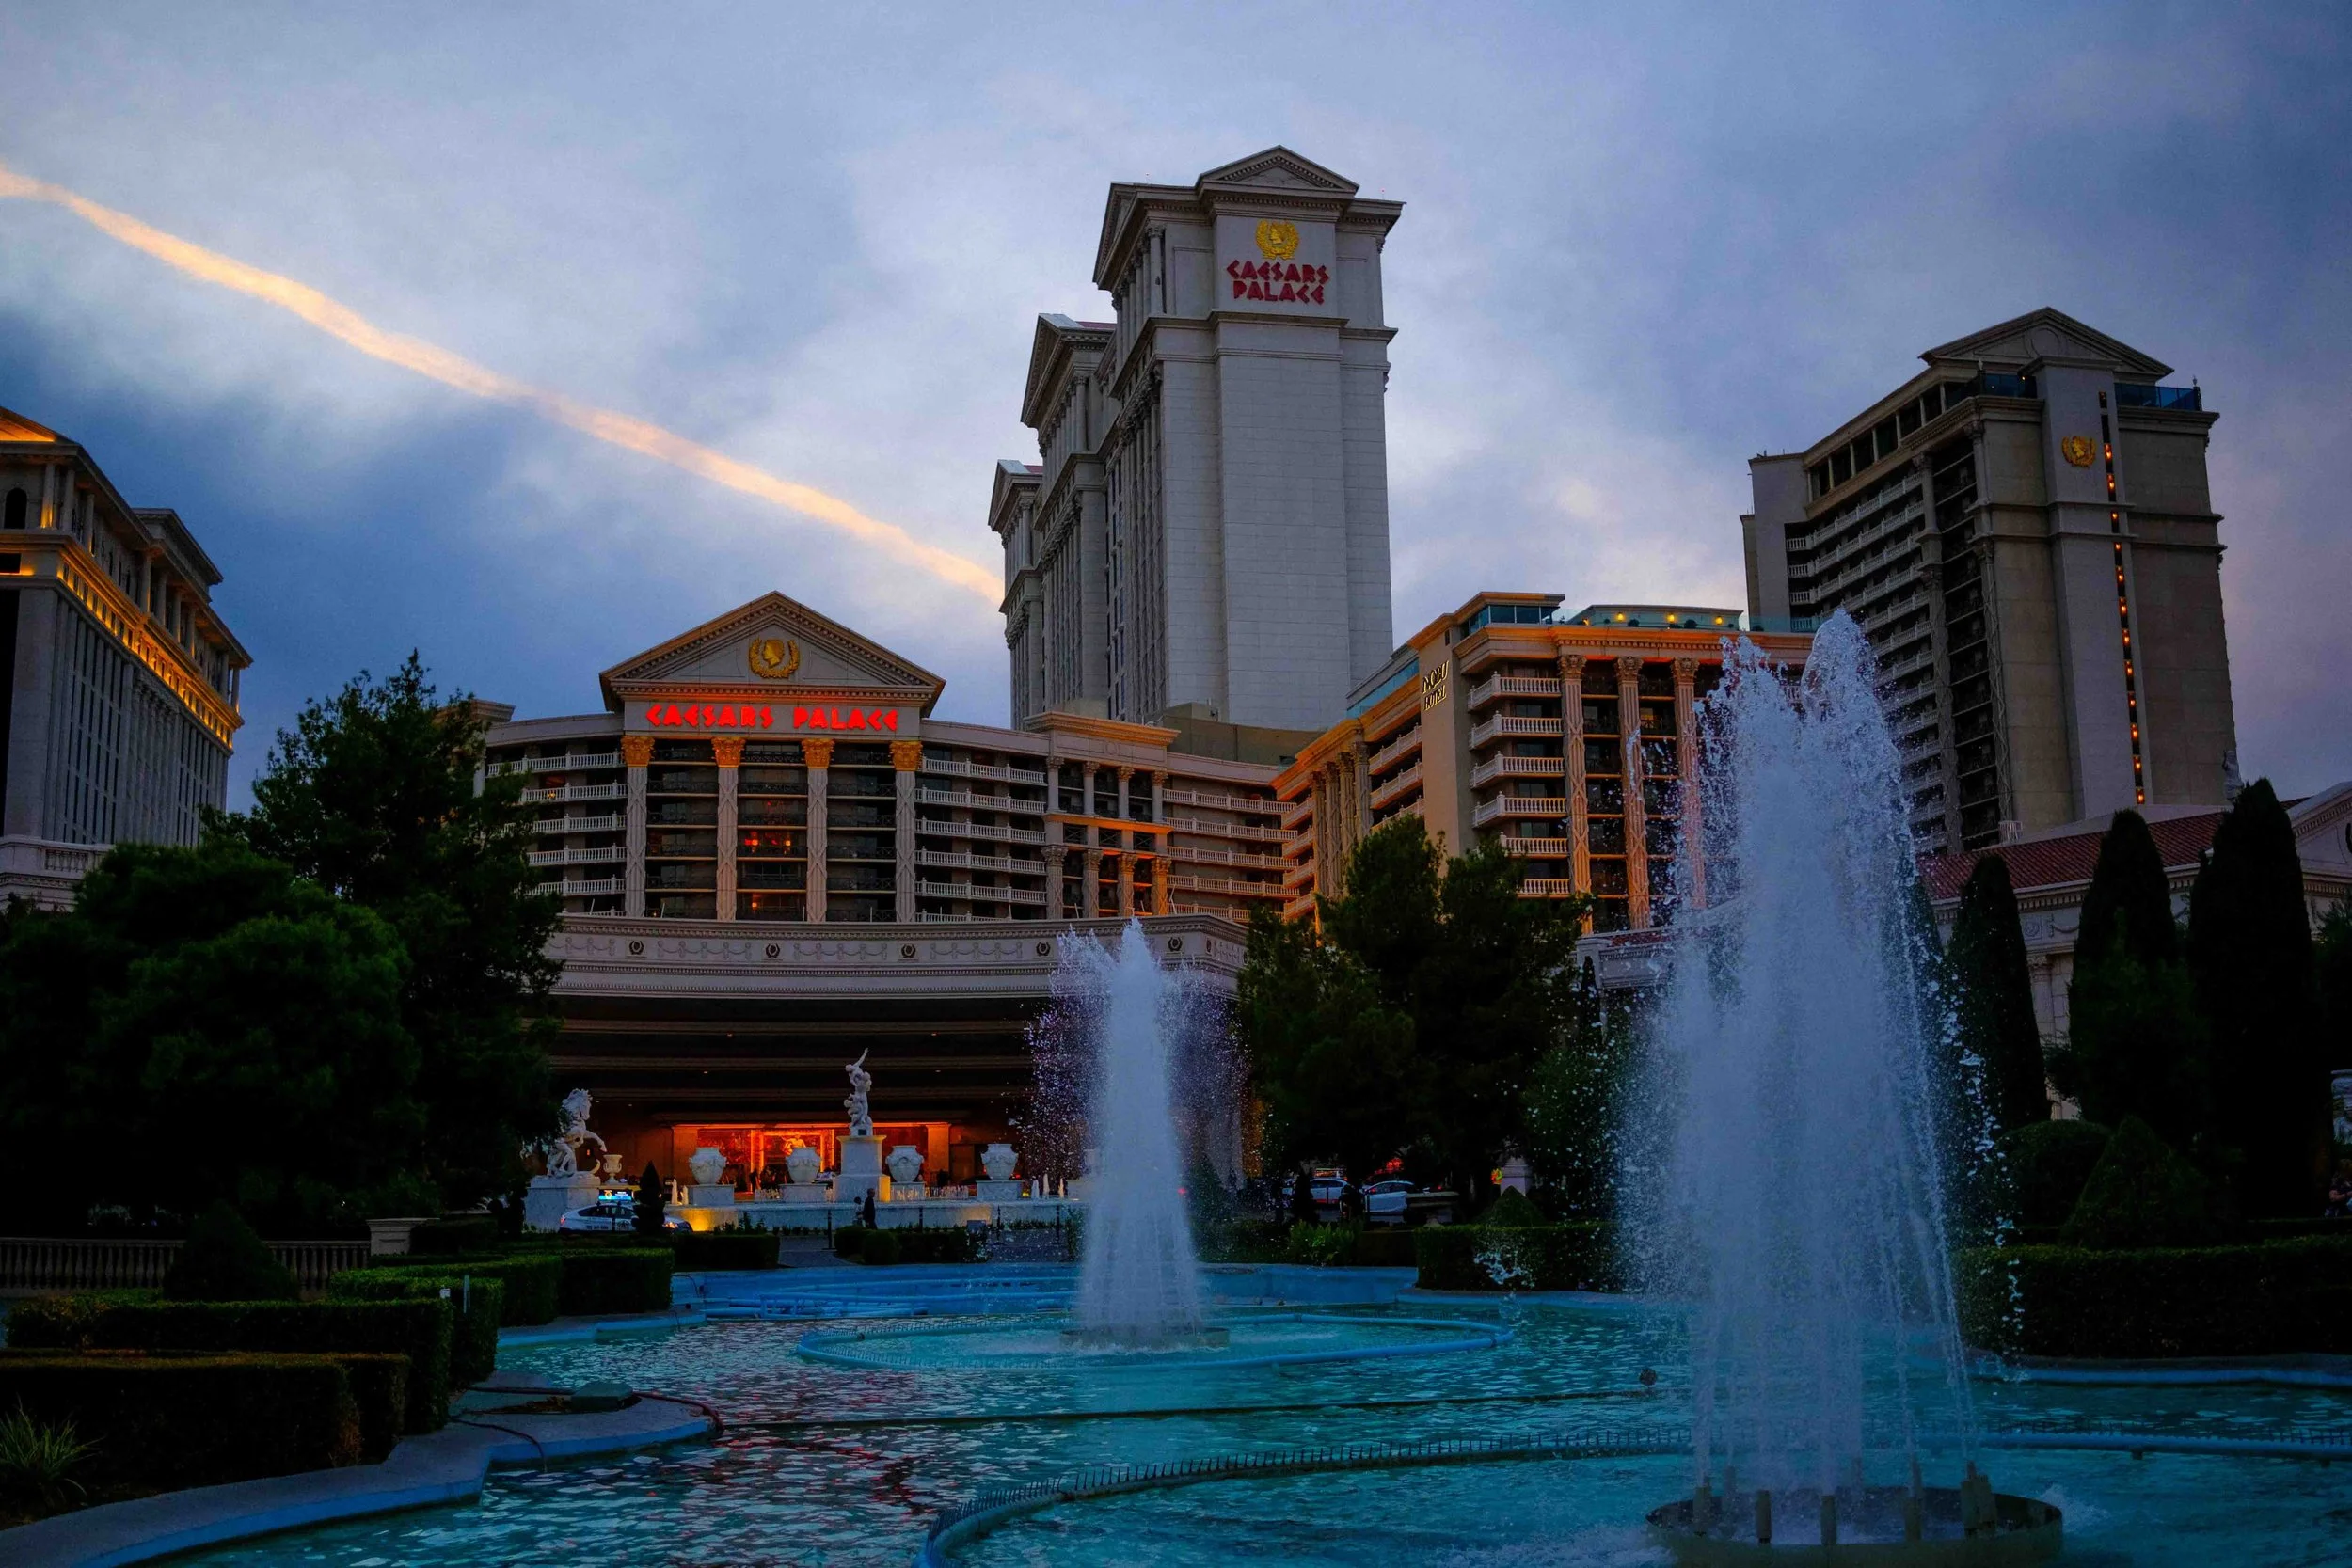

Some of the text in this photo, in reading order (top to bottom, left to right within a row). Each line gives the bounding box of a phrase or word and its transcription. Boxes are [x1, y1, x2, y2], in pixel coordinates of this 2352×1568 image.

[1226, 259, 1329, 284] CAESARS
[1233, 281, 1325, 305] PALACE
[1422, 660, 1449, 694] NOBU
[1424, 685, 1447, 711] HOTEL
[645, 704, 898, 731] CAESARS PALACE
